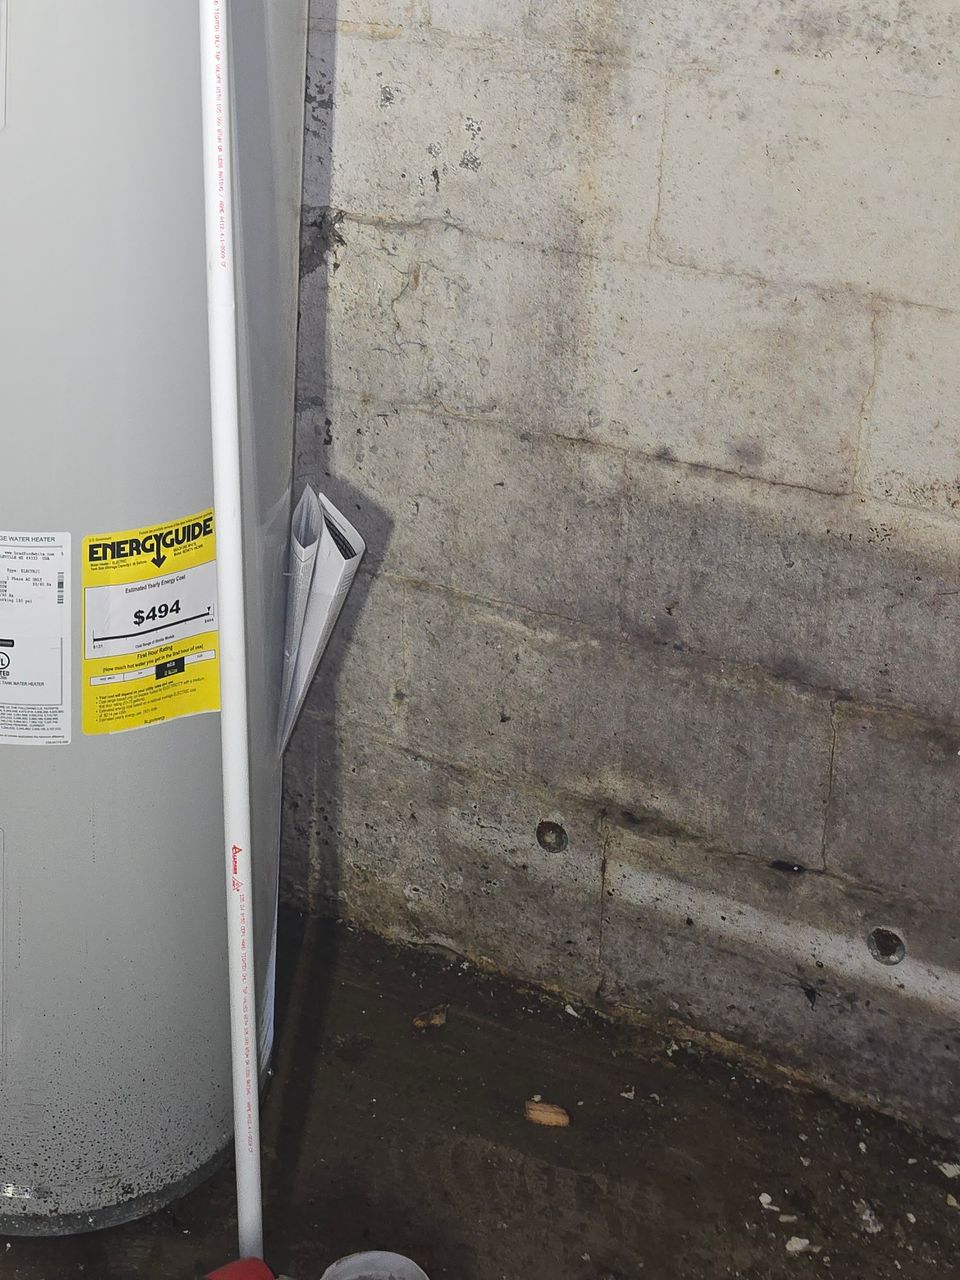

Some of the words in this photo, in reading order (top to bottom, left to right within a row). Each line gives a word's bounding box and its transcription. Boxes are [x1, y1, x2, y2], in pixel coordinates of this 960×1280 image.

[89, 517, 213, 568] ENERGYGUIDE
[125, 584, 147, 594] Estimated
[148, 581, 160, 590] Yearly
[161, 578, 175, 587] Energy
[133, 600, 181, 626] $494
[159, 645, 173, 653] Rating
